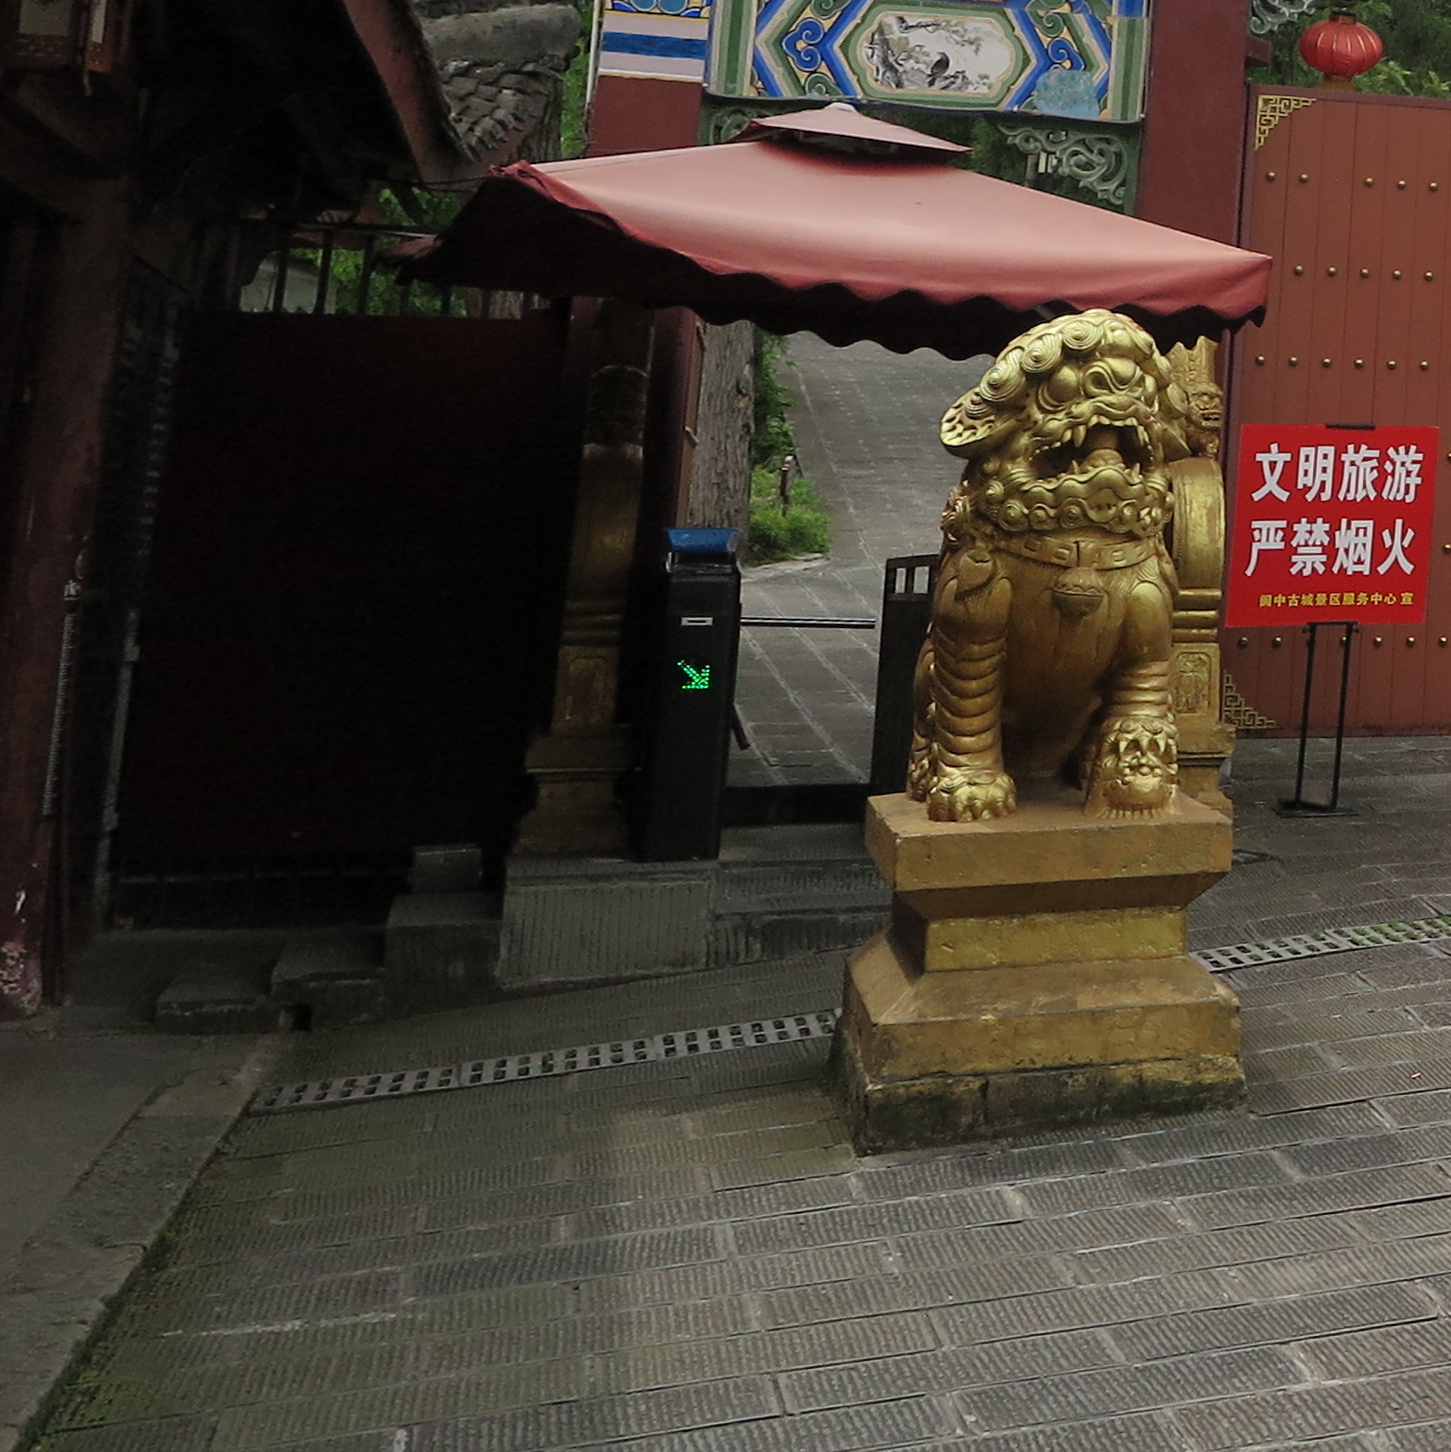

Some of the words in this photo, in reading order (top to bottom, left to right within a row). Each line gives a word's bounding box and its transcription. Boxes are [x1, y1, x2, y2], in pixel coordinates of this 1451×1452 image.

[1251, 443, 1424, 503] 文明旅游
[1244, 517, 1416, 577] 严禁烟火
[1400, 592, 1415, 606] 宣
